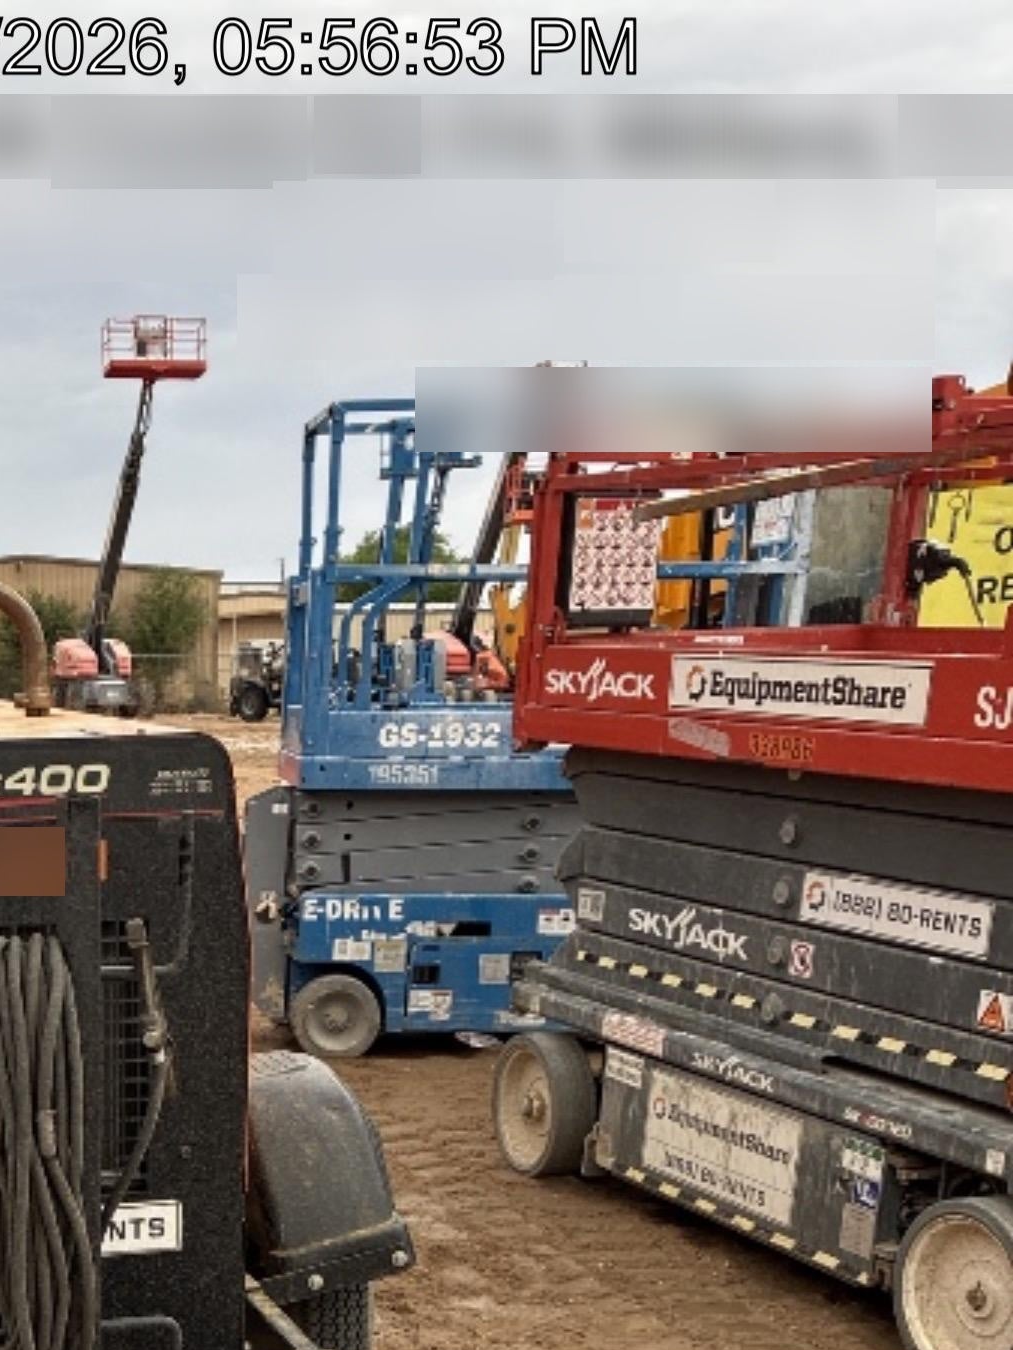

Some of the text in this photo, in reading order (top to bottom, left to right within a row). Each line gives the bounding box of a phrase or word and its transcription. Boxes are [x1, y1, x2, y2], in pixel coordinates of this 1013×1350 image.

[544, 657, 655, 701] SKYJACK
[709, 671, 907, 709] EquipmentShare
[379, 721, 502, 749] GS-1932
[628, 906, 749, 961] SKYJACK
[887, 902, 983, 940] 80-RENTS
